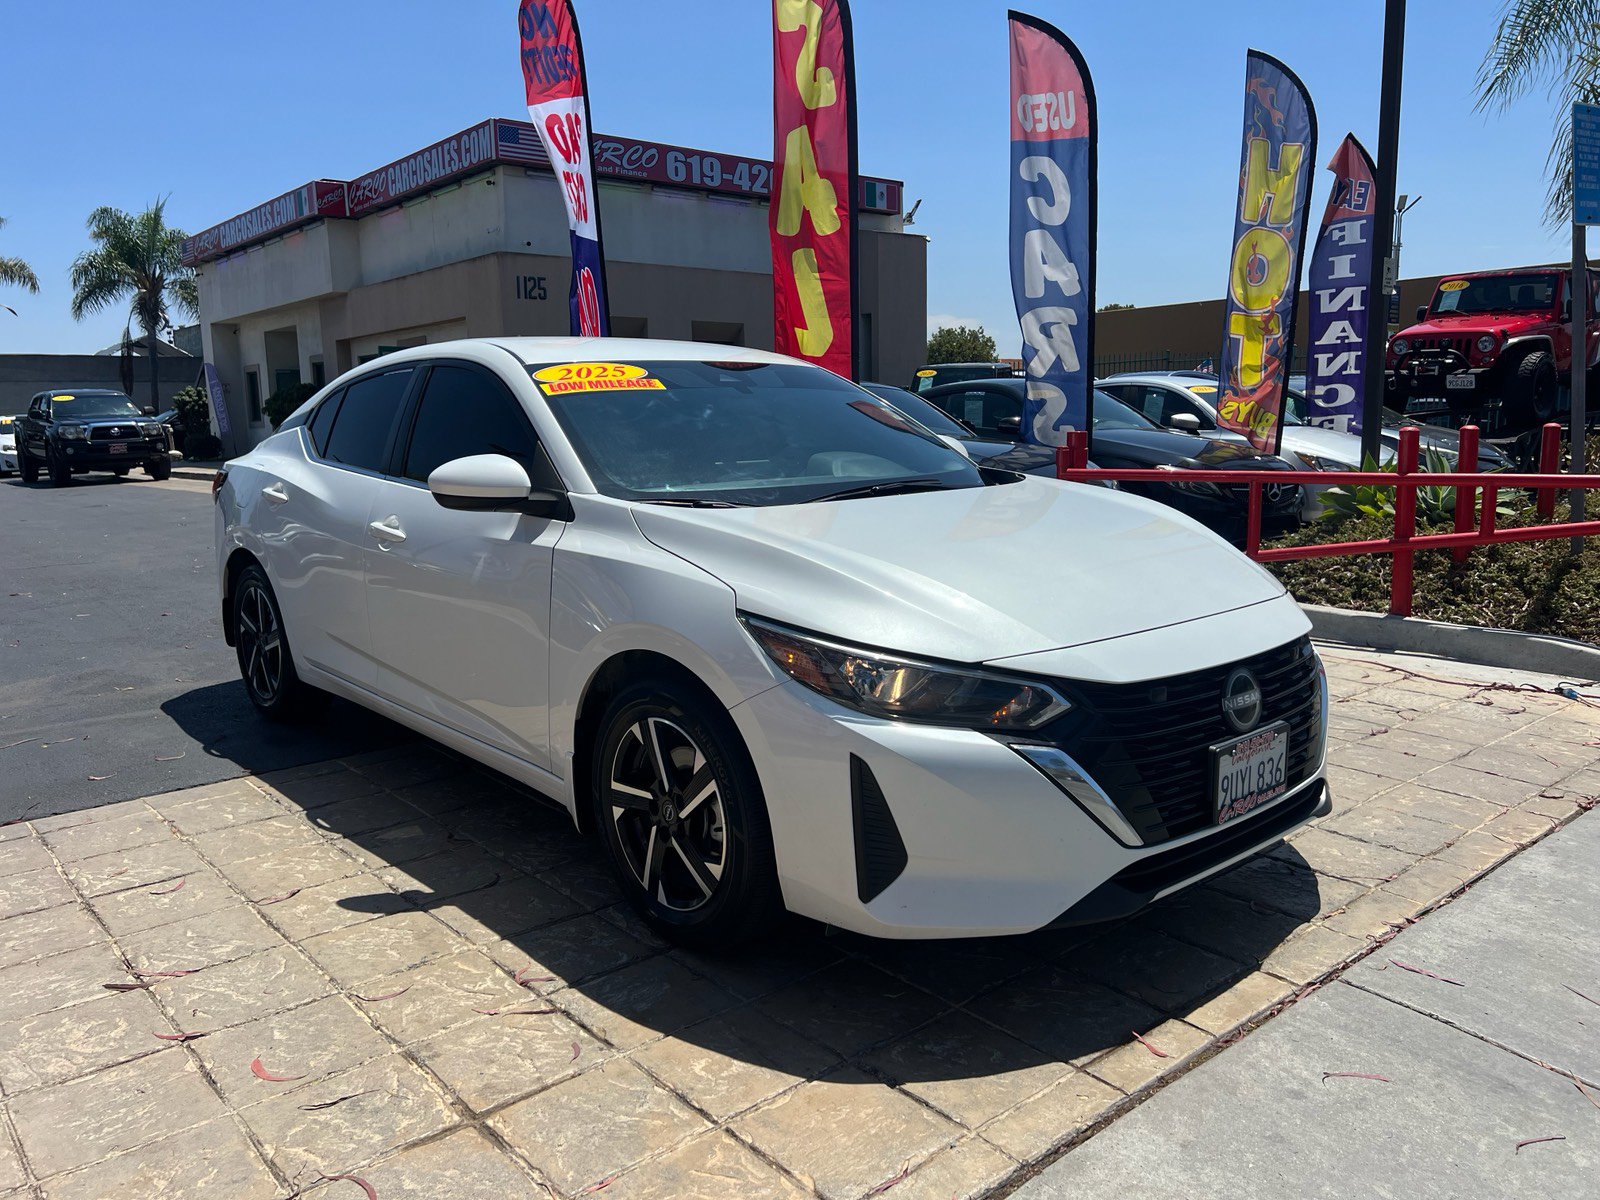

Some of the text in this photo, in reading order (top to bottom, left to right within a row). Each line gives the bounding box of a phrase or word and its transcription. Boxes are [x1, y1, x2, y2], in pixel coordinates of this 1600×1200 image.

[349, 124, 492, 208] CARCO CARCOSALES.COM
[592, 139, 773, 194] RCO 619-42
[597, 165, 648, 178] and Finance
[316, 187, 344, 209] CARCO
[194, 193, 297, 256] CARCO CARCOSALES.COM
[516, 275, 547, 300] 1125
[558, 366, 627, 381] 2025
[549, 379, 657, 393] LOW MILEAGE
[1224, 690, 1261, 710] NISSAN
[1256, 753, 1284, 792] 836
